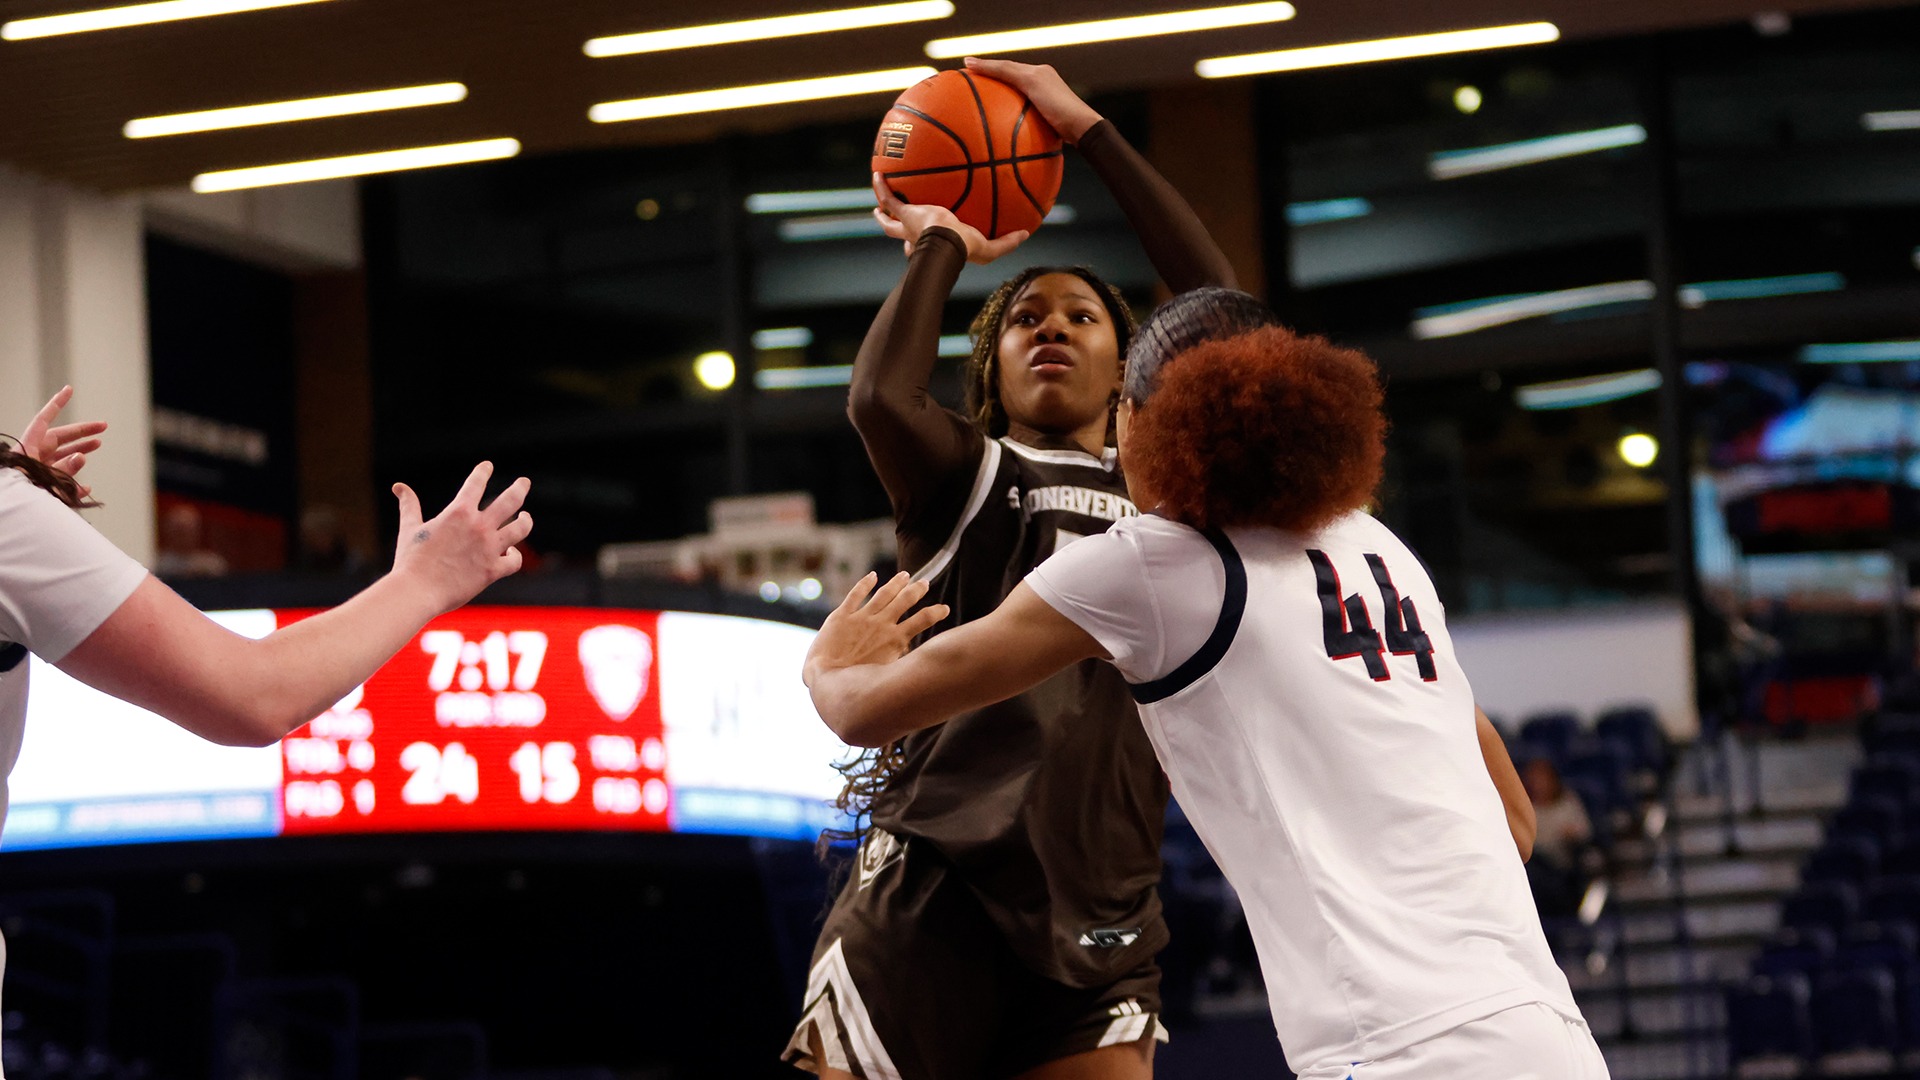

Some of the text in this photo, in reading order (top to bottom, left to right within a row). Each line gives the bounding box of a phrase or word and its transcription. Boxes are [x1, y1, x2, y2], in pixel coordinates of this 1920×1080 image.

[1022, 485, 1140, 523] ONAVENT
[1304, 548, 1439, 683] 44
[420, 630, 549, 692] 7:17
[399, 741, 480, 805] 24
[509, 741, 581, 804] 15
